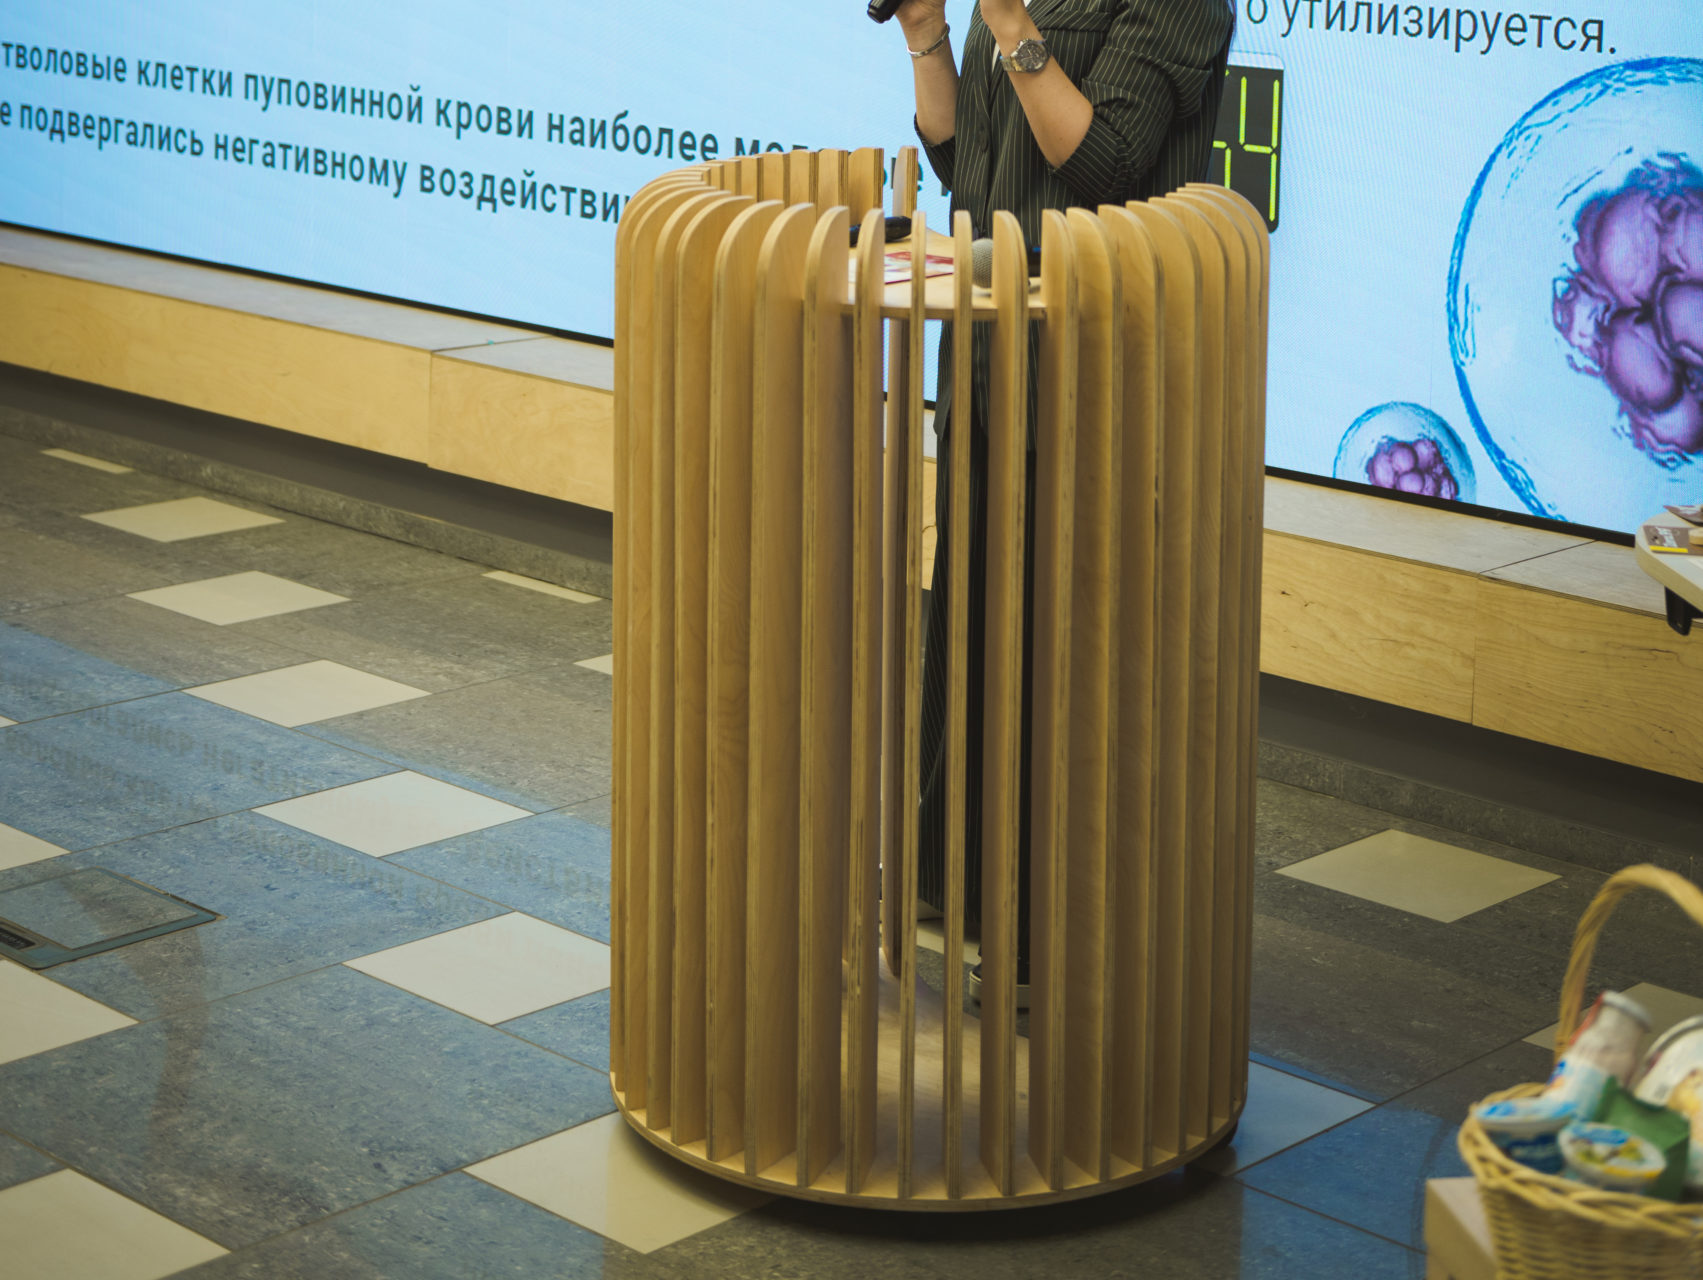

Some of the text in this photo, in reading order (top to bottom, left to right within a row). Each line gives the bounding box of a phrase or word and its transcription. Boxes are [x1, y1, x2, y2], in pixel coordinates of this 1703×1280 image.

[1, 41, 718, 161] тволовые клетки пуповинной крови наиболее
[20, 104, 204, 157] подвергались
[214, 133, 408, 199] негативному
[420, 164, 631, 224] воздействи
